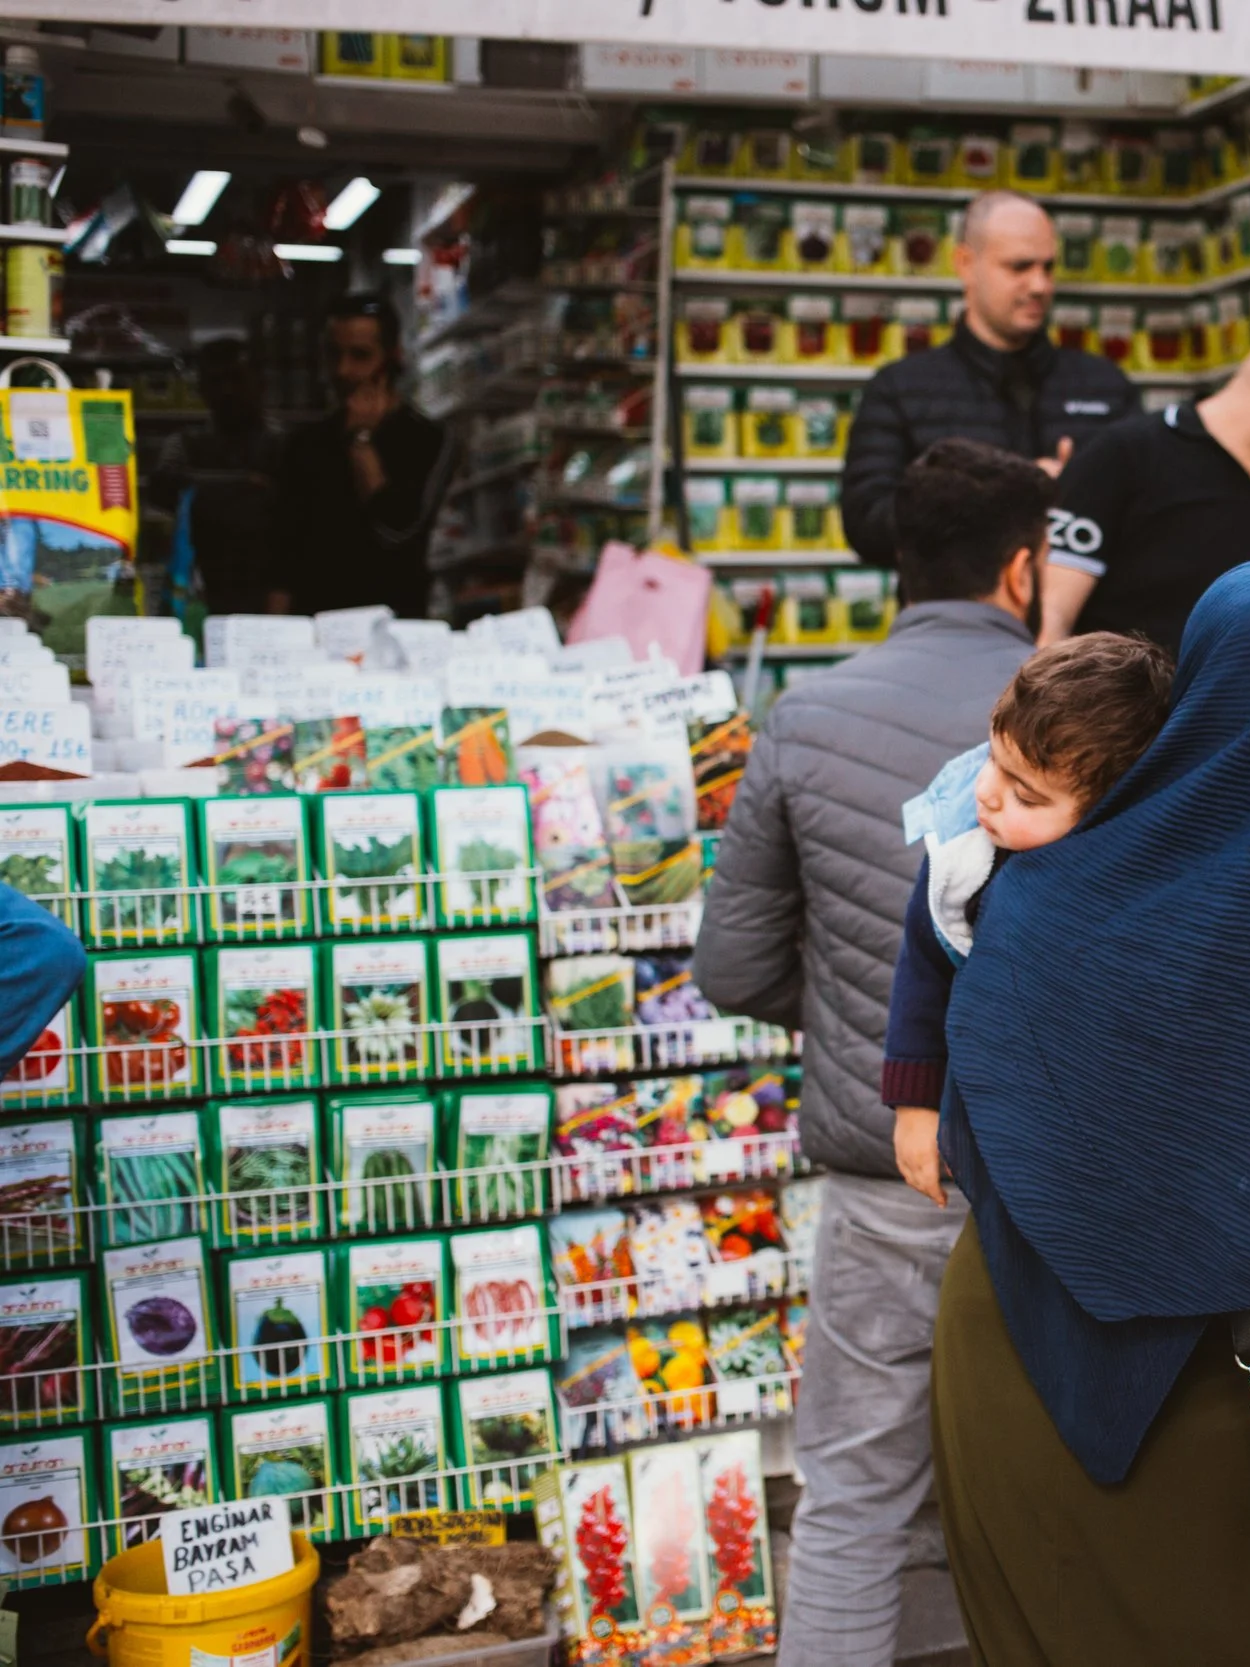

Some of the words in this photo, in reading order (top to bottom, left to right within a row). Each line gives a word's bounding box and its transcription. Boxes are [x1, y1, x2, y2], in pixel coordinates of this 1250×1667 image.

[0, 467, 89, 493] RRING
[0, 710, 55, 736] ERE
[181, 1502, 274, 1544] ENGİNAR
[173, 1532, 260, 1573] BAYRAM
[187, 1555, 257, 1594] PAŞA
